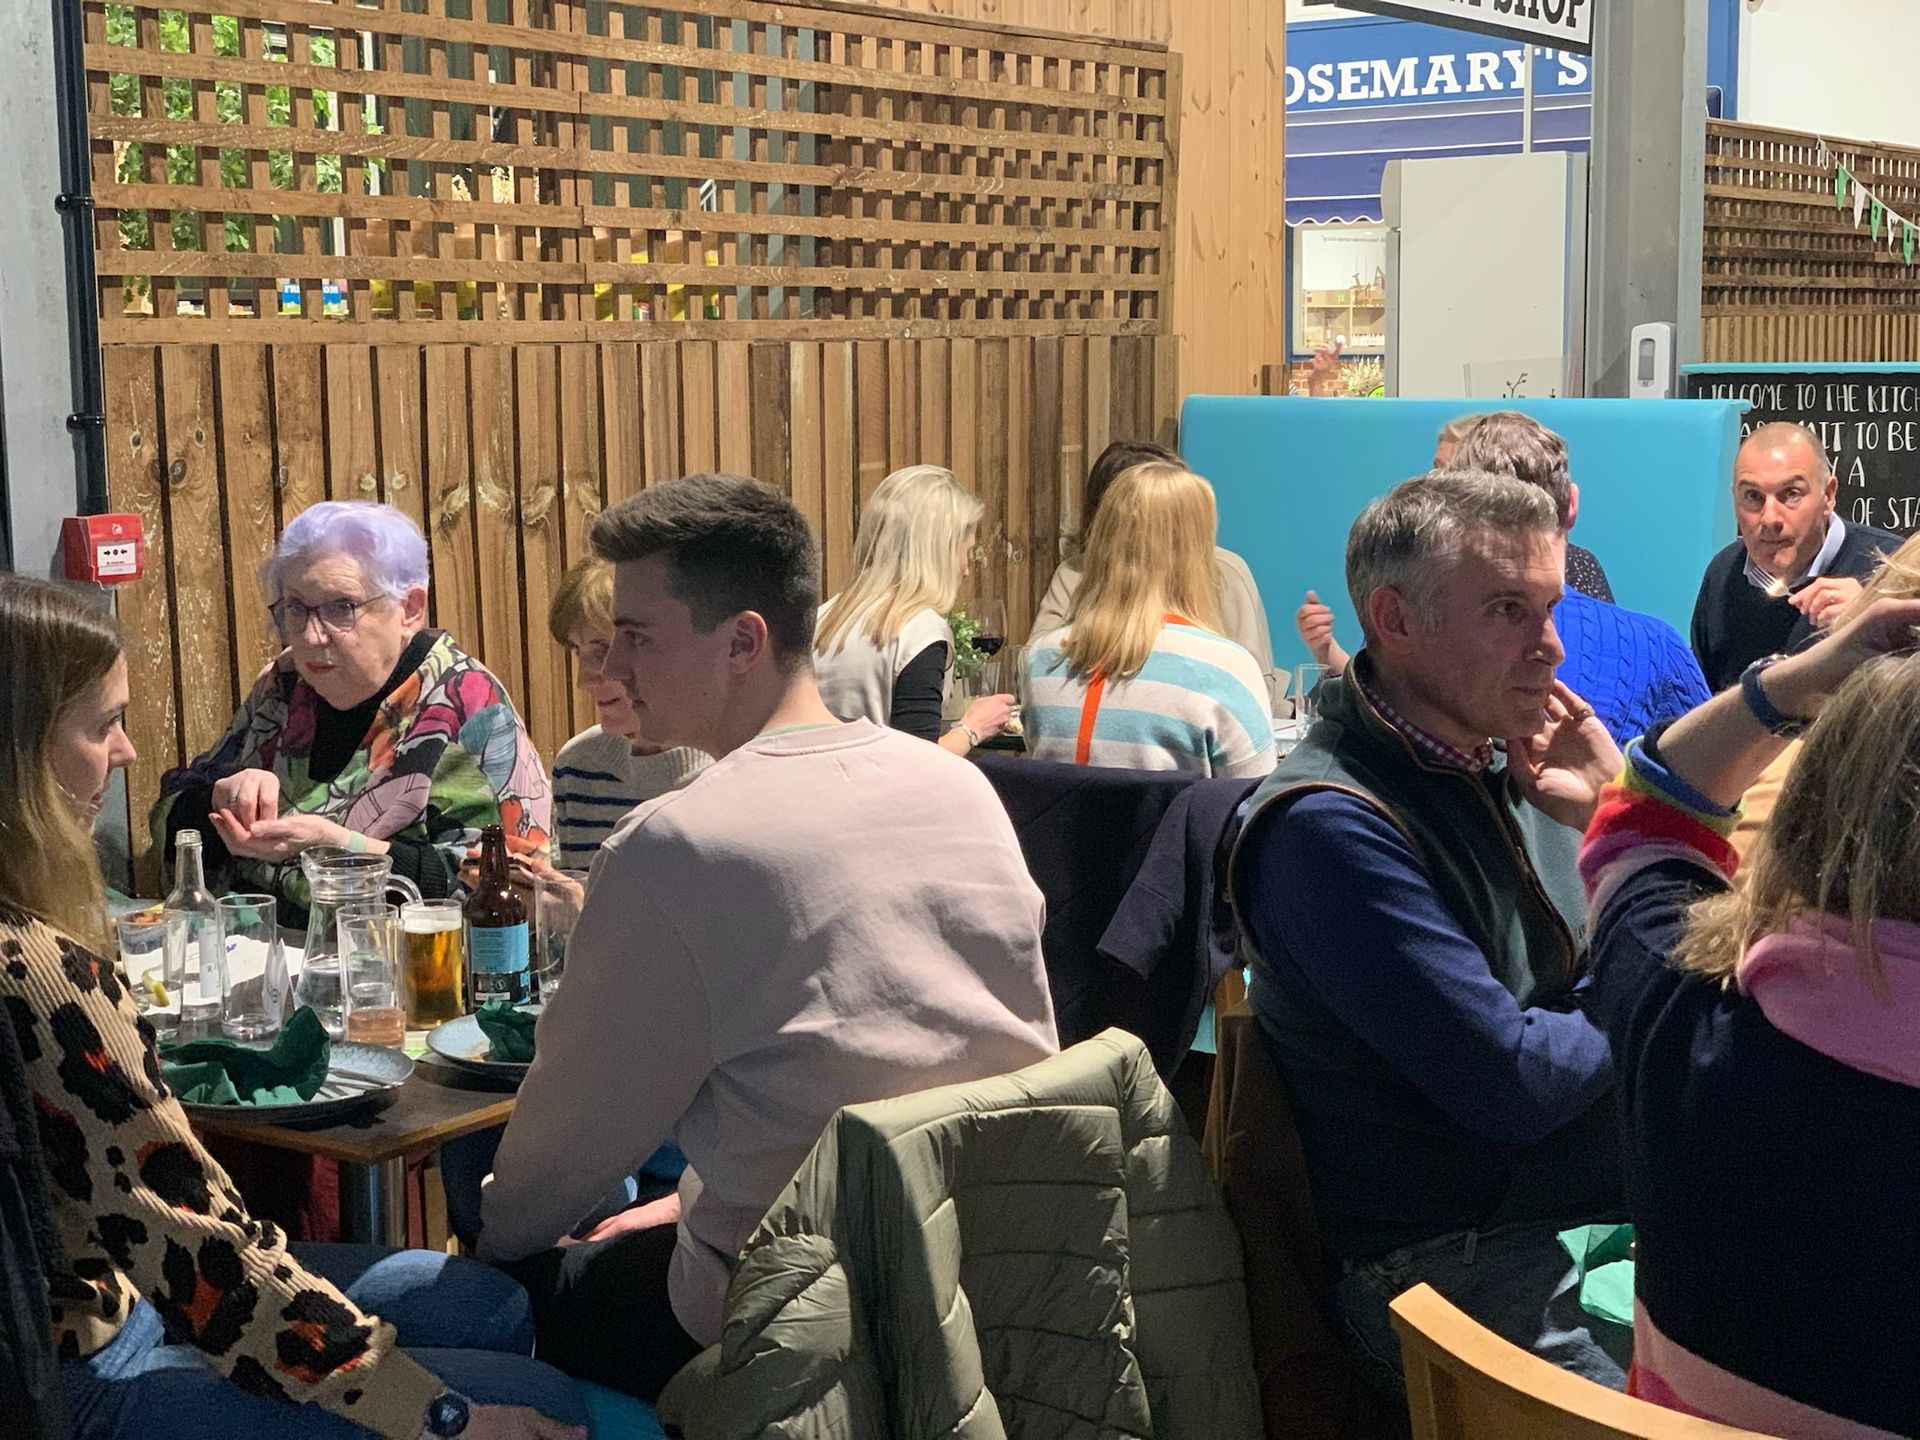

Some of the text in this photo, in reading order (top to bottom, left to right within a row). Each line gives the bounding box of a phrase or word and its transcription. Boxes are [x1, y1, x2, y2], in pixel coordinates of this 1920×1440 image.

[1494, 0, 1585, 28] OP
[1795, 383, 1816, 411] TO
[1824, 383, 1860, 412] THE
[1798, 420, 1846, 452] IT
[1854, 421, 1879, 450] TO
[1888, 420, 1918, 452] BE
[1848, 456, 1865, 487] A
[1851, 497, 1876, 526] OF
